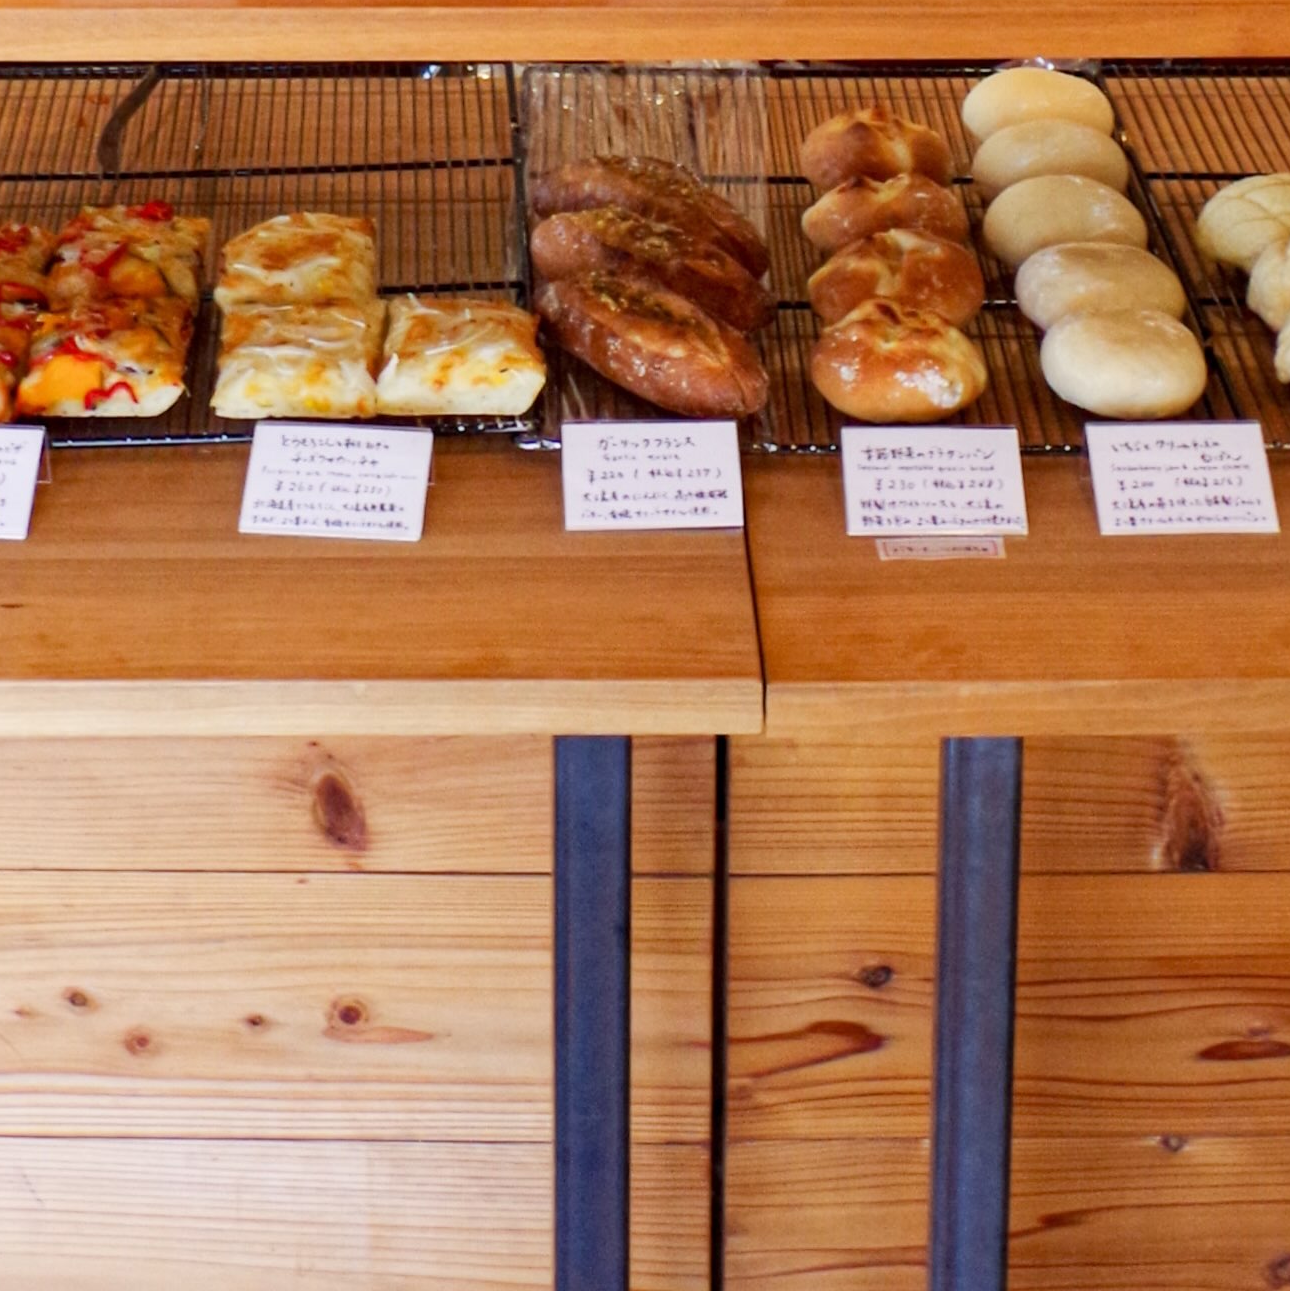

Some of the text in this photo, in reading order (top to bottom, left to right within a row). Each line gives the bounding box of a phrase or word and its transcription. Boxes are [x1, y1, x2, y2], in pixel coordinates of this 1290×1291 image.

[598, 435, 696, 450] ガーリックフランス
